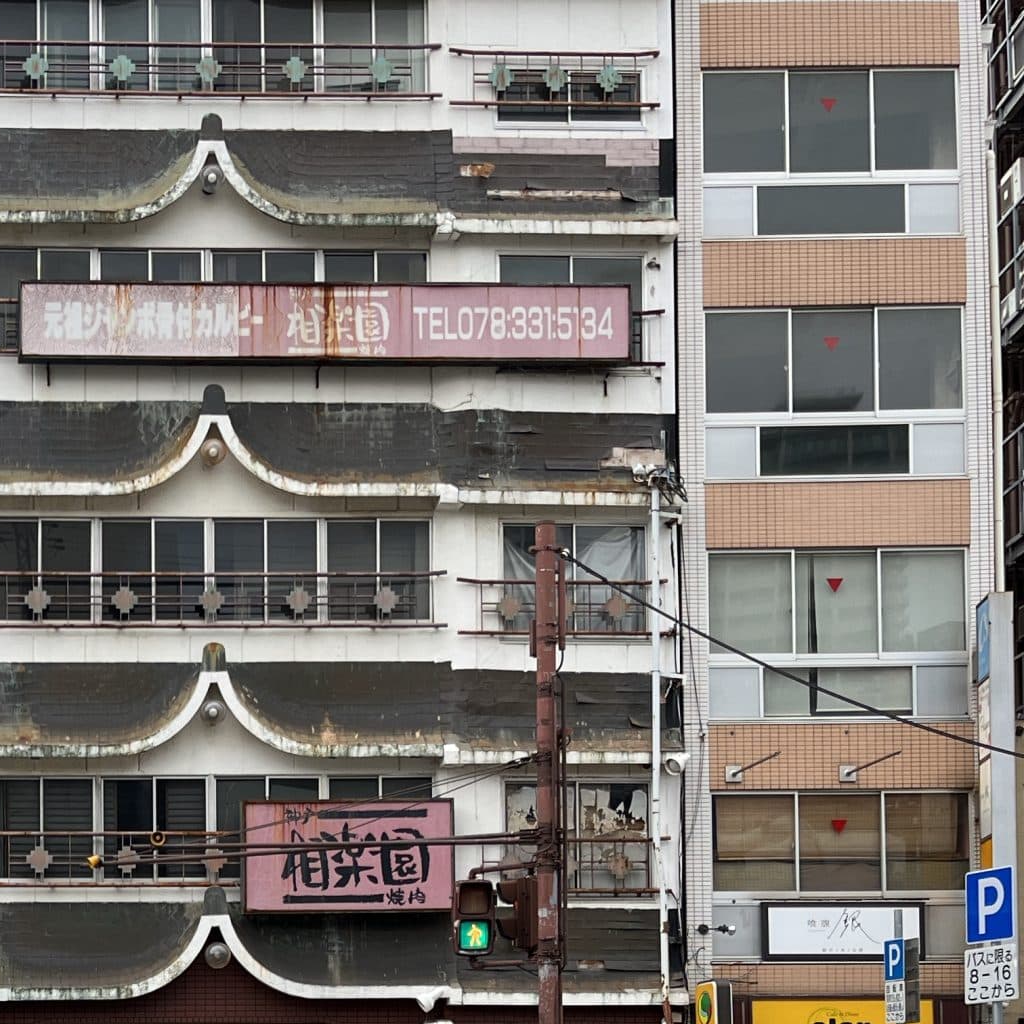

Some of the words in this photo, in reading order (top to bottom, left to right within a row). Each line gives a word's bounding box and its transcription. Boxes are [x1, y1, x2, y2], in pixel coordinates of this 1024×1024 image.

[386, 887, 426, 905] 焼肉
[977, 876, 1005, 935] P
[888, 944, 901, 976] P
[967, 949, 1013, 967] バスに限る
[970, 964, 1011, 984] 8-16
[968, 983, 1015, 1000] ここから
